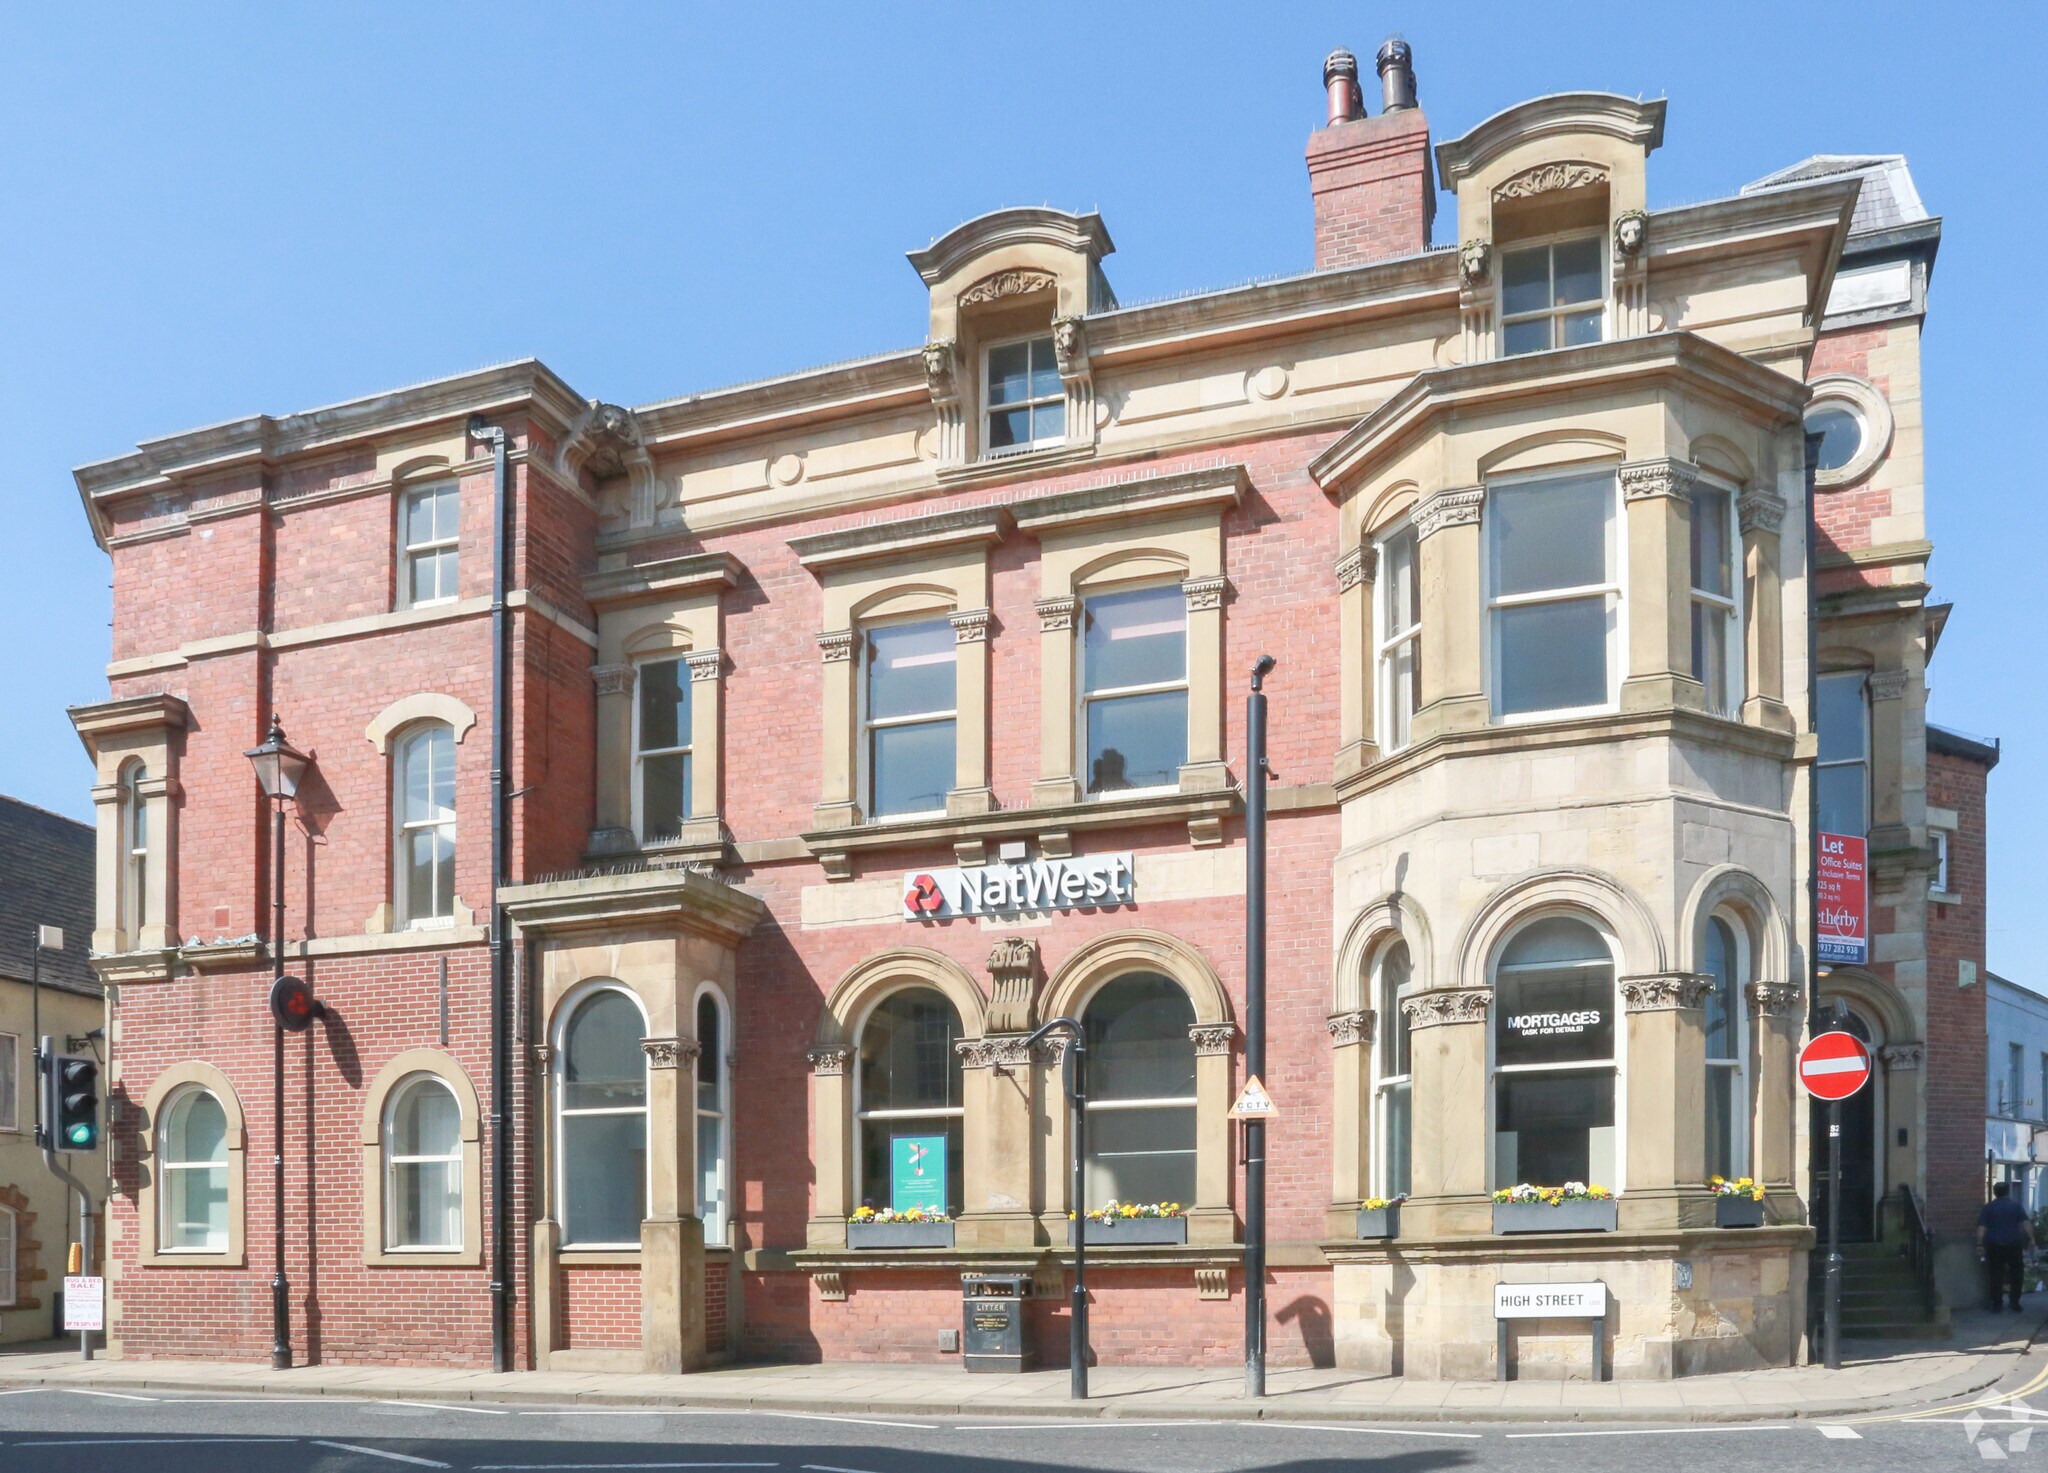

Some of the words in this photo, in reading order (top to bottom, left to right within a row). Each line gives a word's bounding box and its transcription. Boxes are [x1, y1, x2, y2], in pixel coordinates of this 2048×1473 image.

[1822, 835, 1844, 854] Let
[1821, 856, 1841, 868] Office
[1842, 859, 1862, 871] Suites
[1822, 869, 1844, 879] Inclusive
[1846, 871, 1860, 880] Terms
[956, 857, 1125, 909] NatWest
[1818, 907, 1859, 927] etherby
[1833, 944, 1845, 953] 282
[1846, 945, 1859, 955] 938
[1508, 1011, 1600, 1029] MORTGAGES
[1540, 1027, 1553, 1035] FOR
[1555, 1025, 1584, 1034] DETAILS)
[1501, 1295, 1530, 1307] HIGH
[1536, 1294, 1584, 1306] STREET
